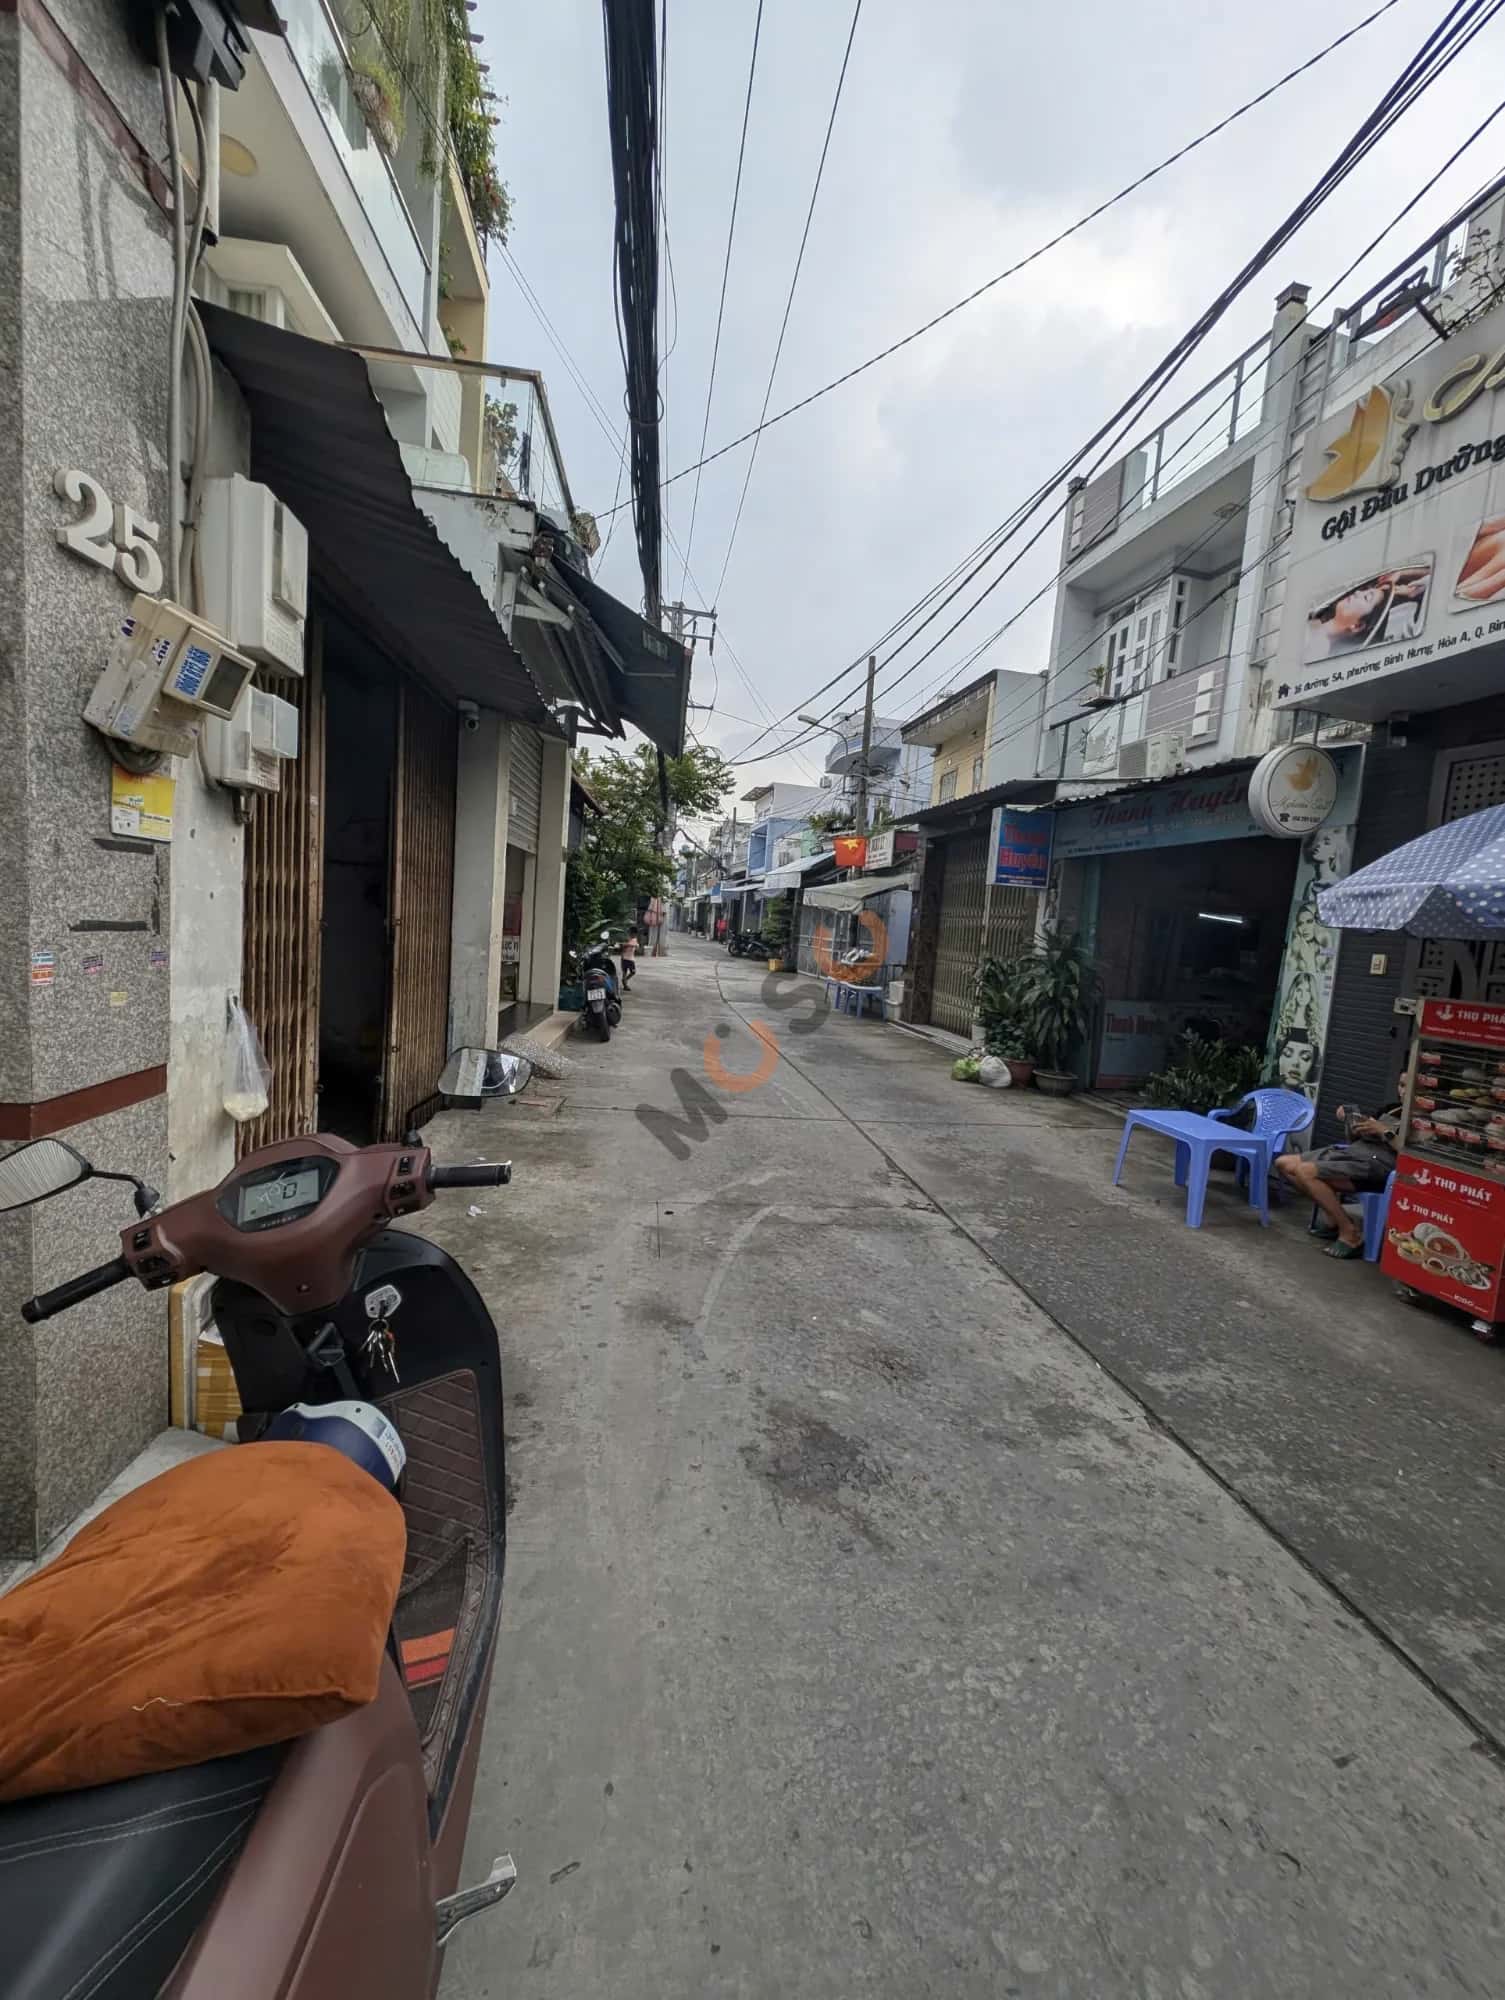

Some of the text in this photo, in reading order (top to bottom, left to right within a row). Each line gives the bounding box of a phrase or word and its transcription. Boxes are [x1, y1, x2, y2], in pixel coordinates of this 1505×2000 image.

[54, 468, 163, 594] 25
[1433, 1176, 1492, 1202] THỌ PHÁT
[1412, 1204, 1455, 1225] THỌ PHÁT
